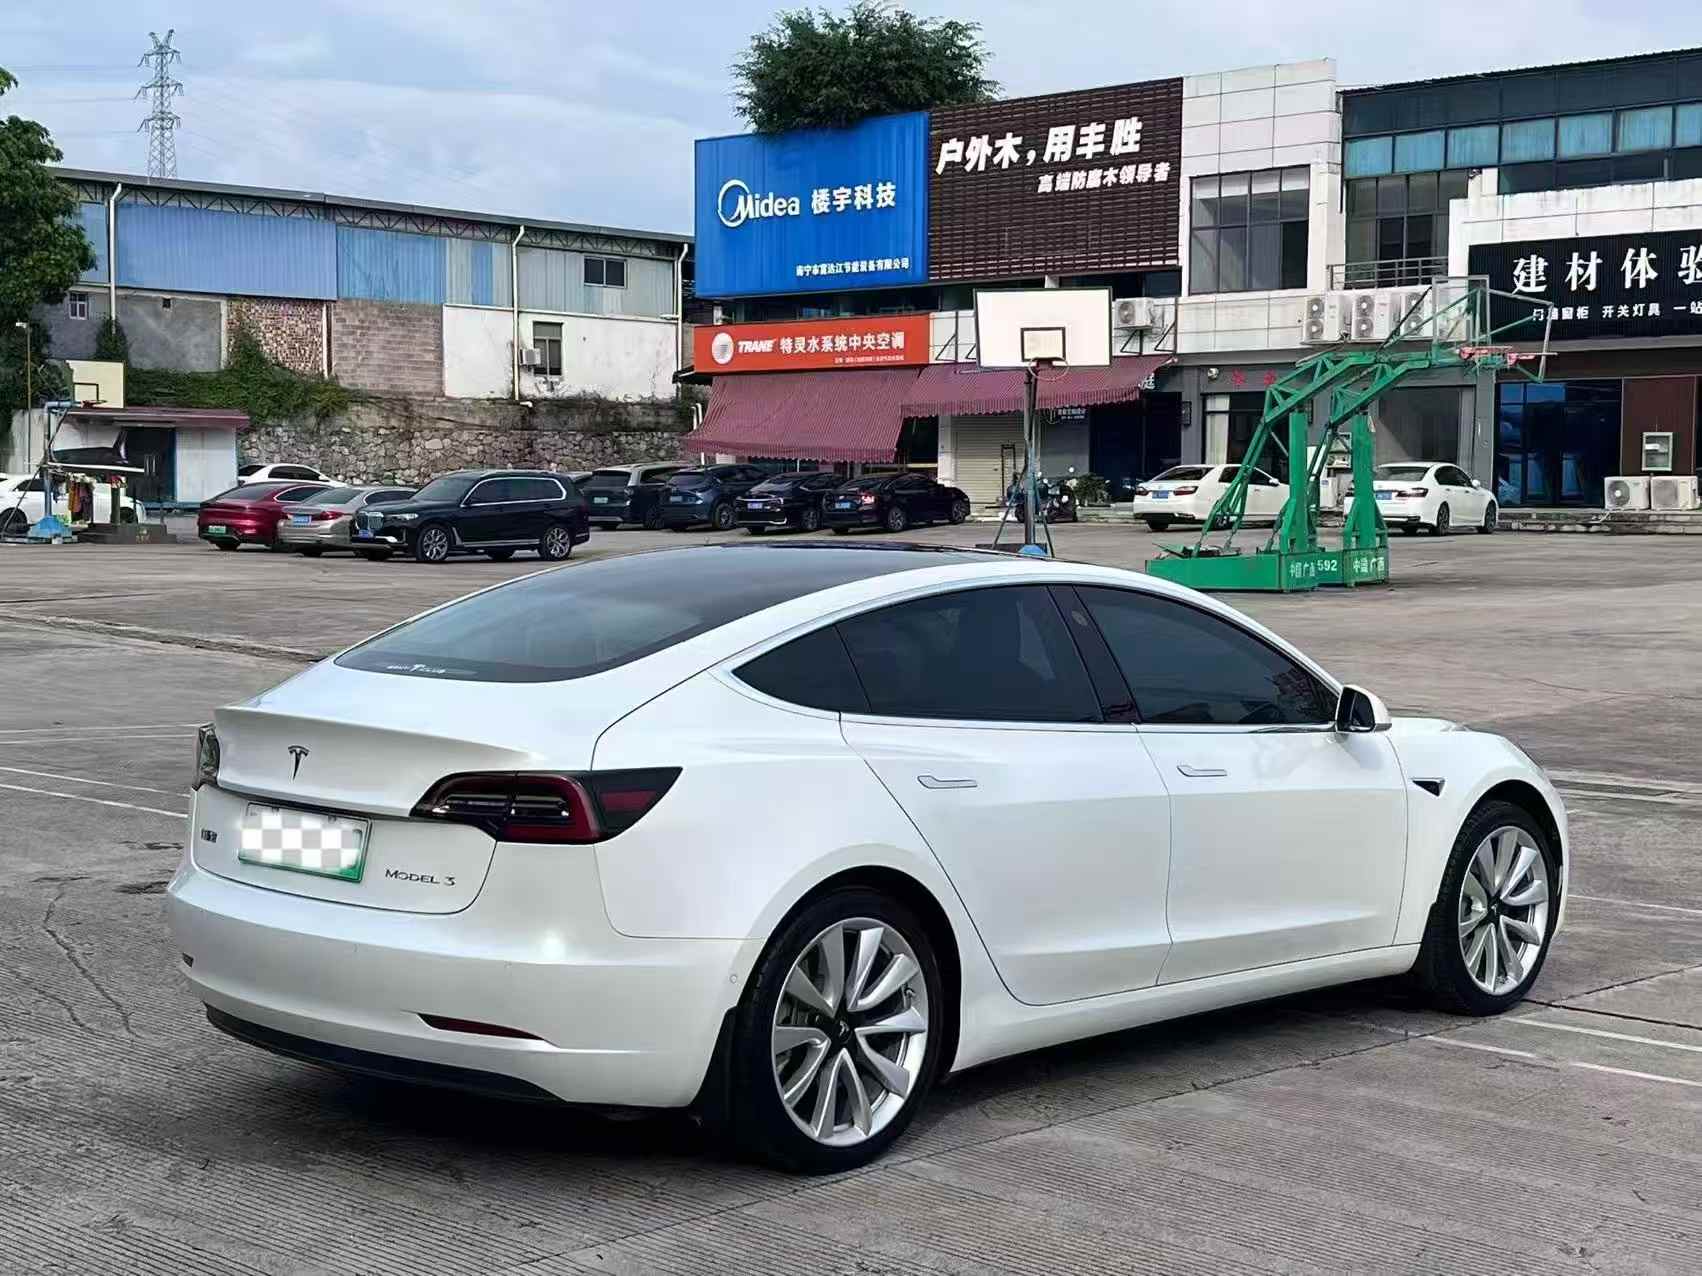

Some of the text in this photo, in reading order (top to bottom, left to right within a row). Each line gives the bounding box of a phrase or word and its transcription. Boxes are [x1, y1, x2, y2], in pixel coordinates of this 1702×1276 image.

[1037, 162, 1170, 193] 高端防腐木领导者
[718, 179, 800, 228] Midea
[811, 182, 896, 215] 楼宇科技
[1602, 303, 1661, 318] 开关灯具
[738, 340, 774, 353] TRANE
[780, 332, 905, 354] 特灵水系统中央空调
[385, 869, 456, 887] MODEL 3
